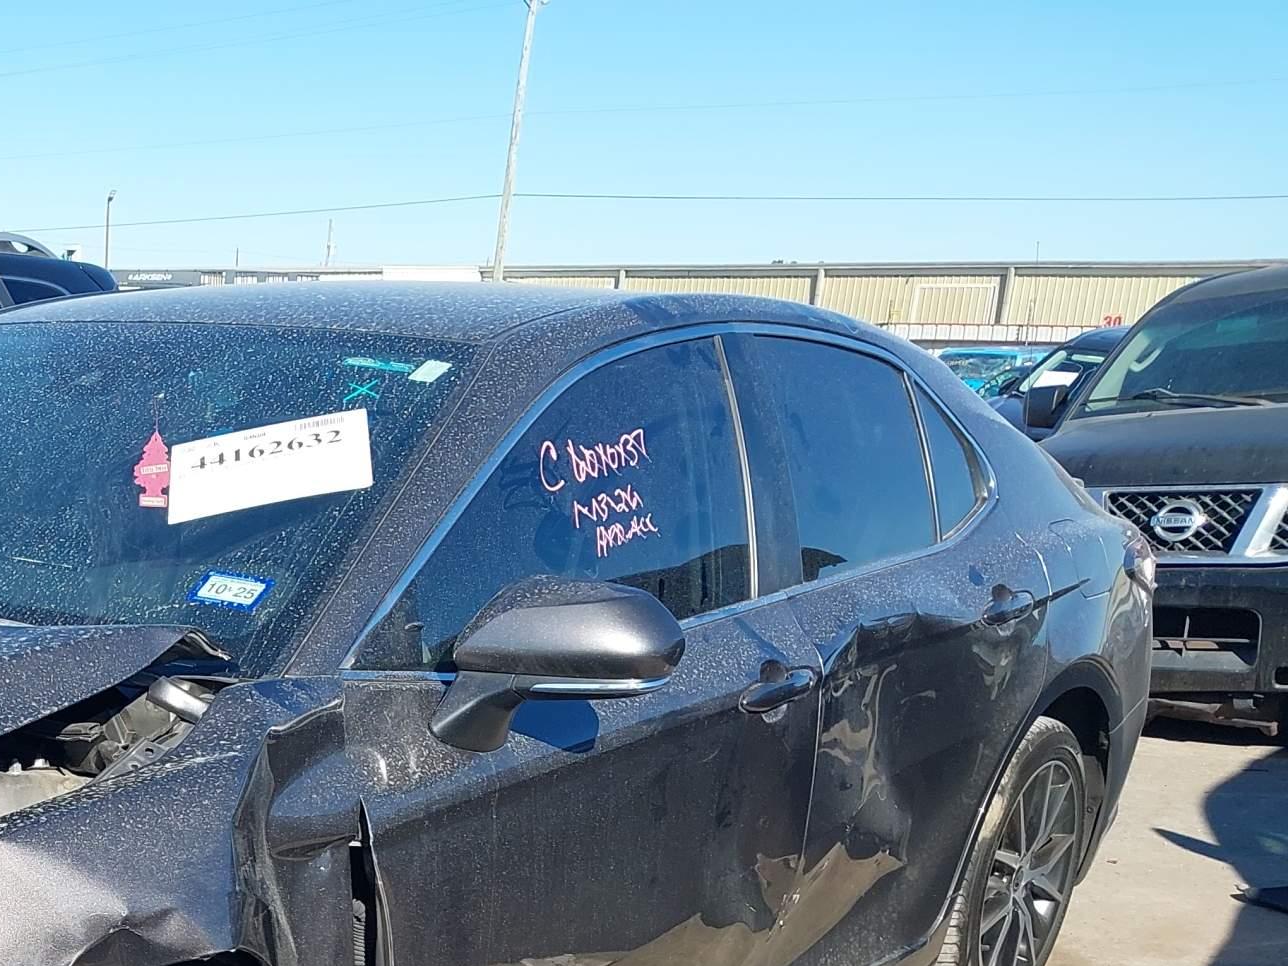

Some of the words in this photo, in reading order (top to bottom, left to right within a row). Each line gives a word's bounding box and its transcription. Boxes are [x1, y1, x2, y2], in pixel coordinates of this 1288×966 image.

[191, 429, 343, 470] 44162632
[207, 582, 227, 596] 10
[232, 586, 257, 600] 25
